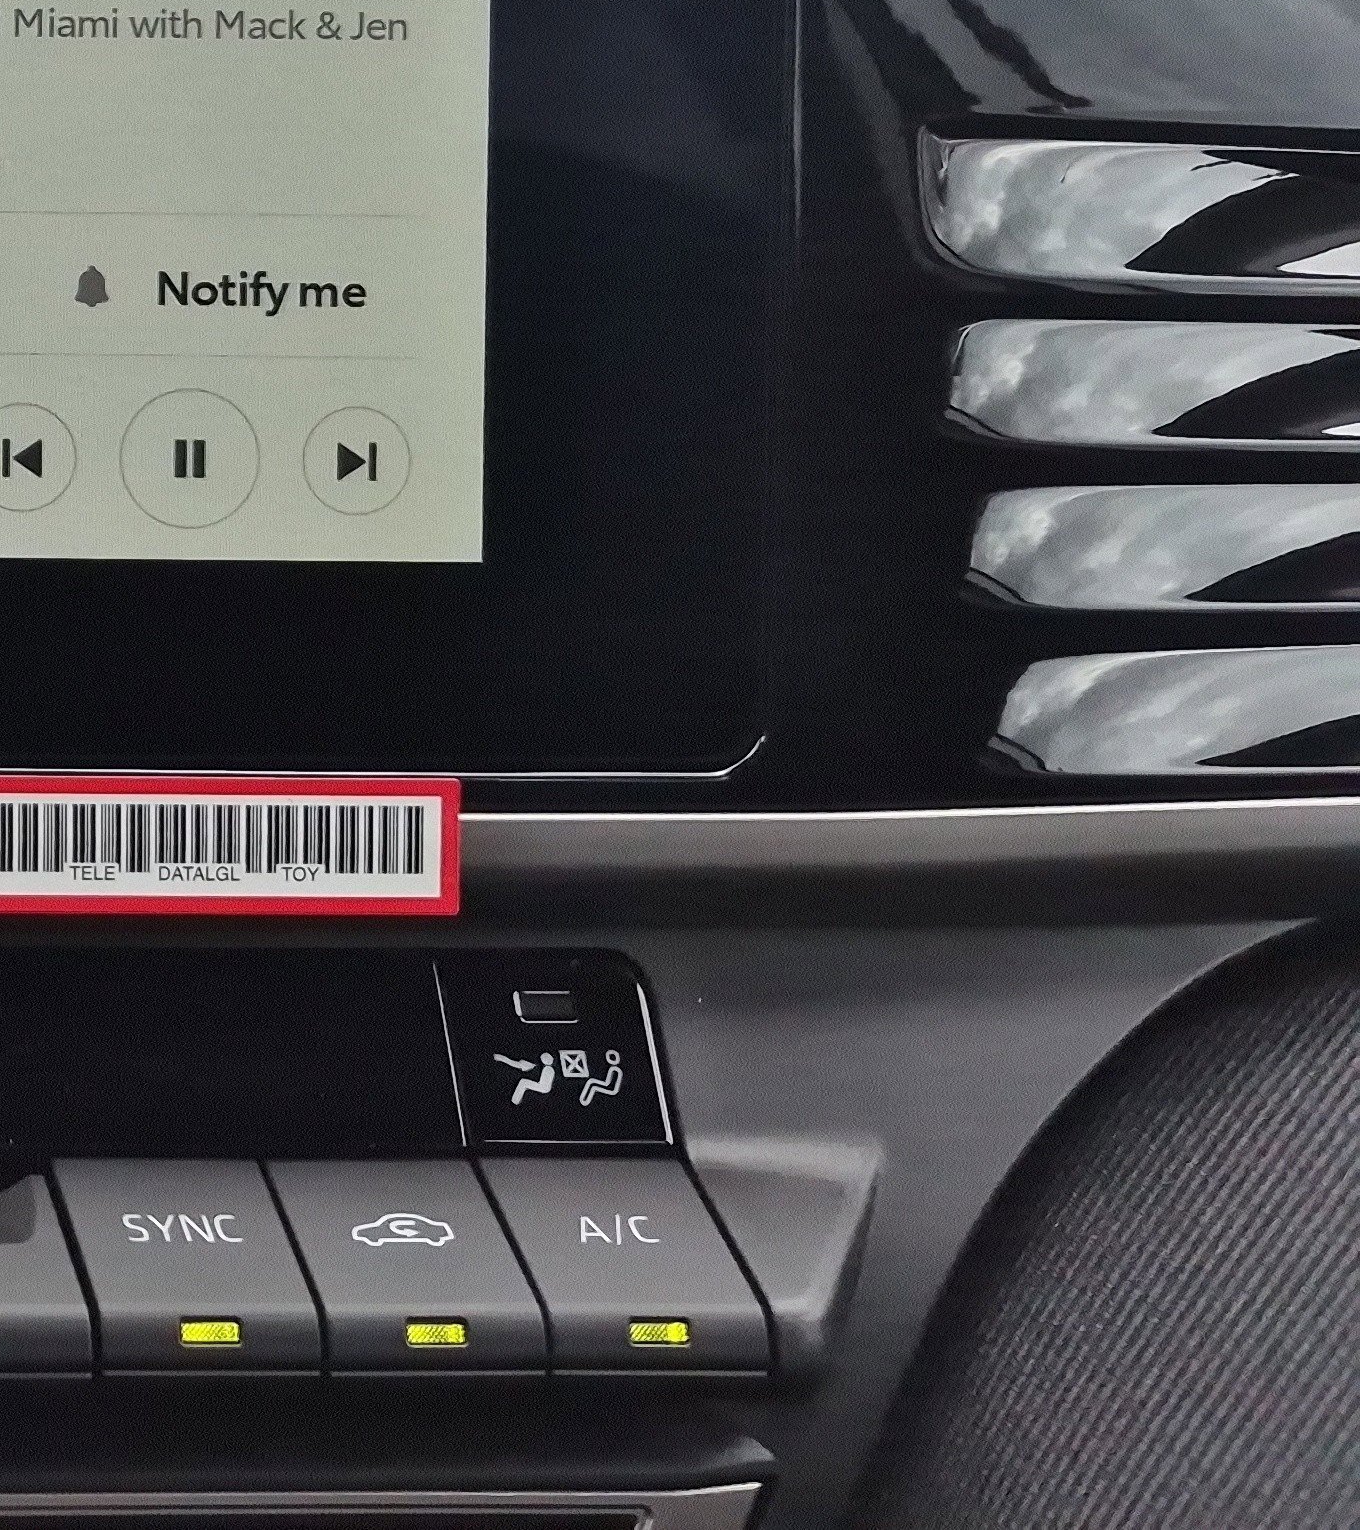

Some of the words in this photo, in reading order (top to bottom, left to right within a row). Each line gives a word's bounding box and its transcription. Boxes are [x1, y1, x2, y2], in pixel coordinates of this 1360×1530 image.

[13, 6, 119, 40] Miami
[129, 7, 203, 40] with
[215, 8, 307, 42] Mack
[315, 9, 342, 41] &
[350, 10, 408, 42] Jen
[158, 270, 290, 318] Notify
[299, 282, 367, 309] me
[69, 865, 116, 882] TELE
[157, 865, 241, 882] DATALGL
[283, 866, 320, 882] TOY
[122, 1213, 243, 1244] SYNC
[579, 1214, 660, 1246] A/C
